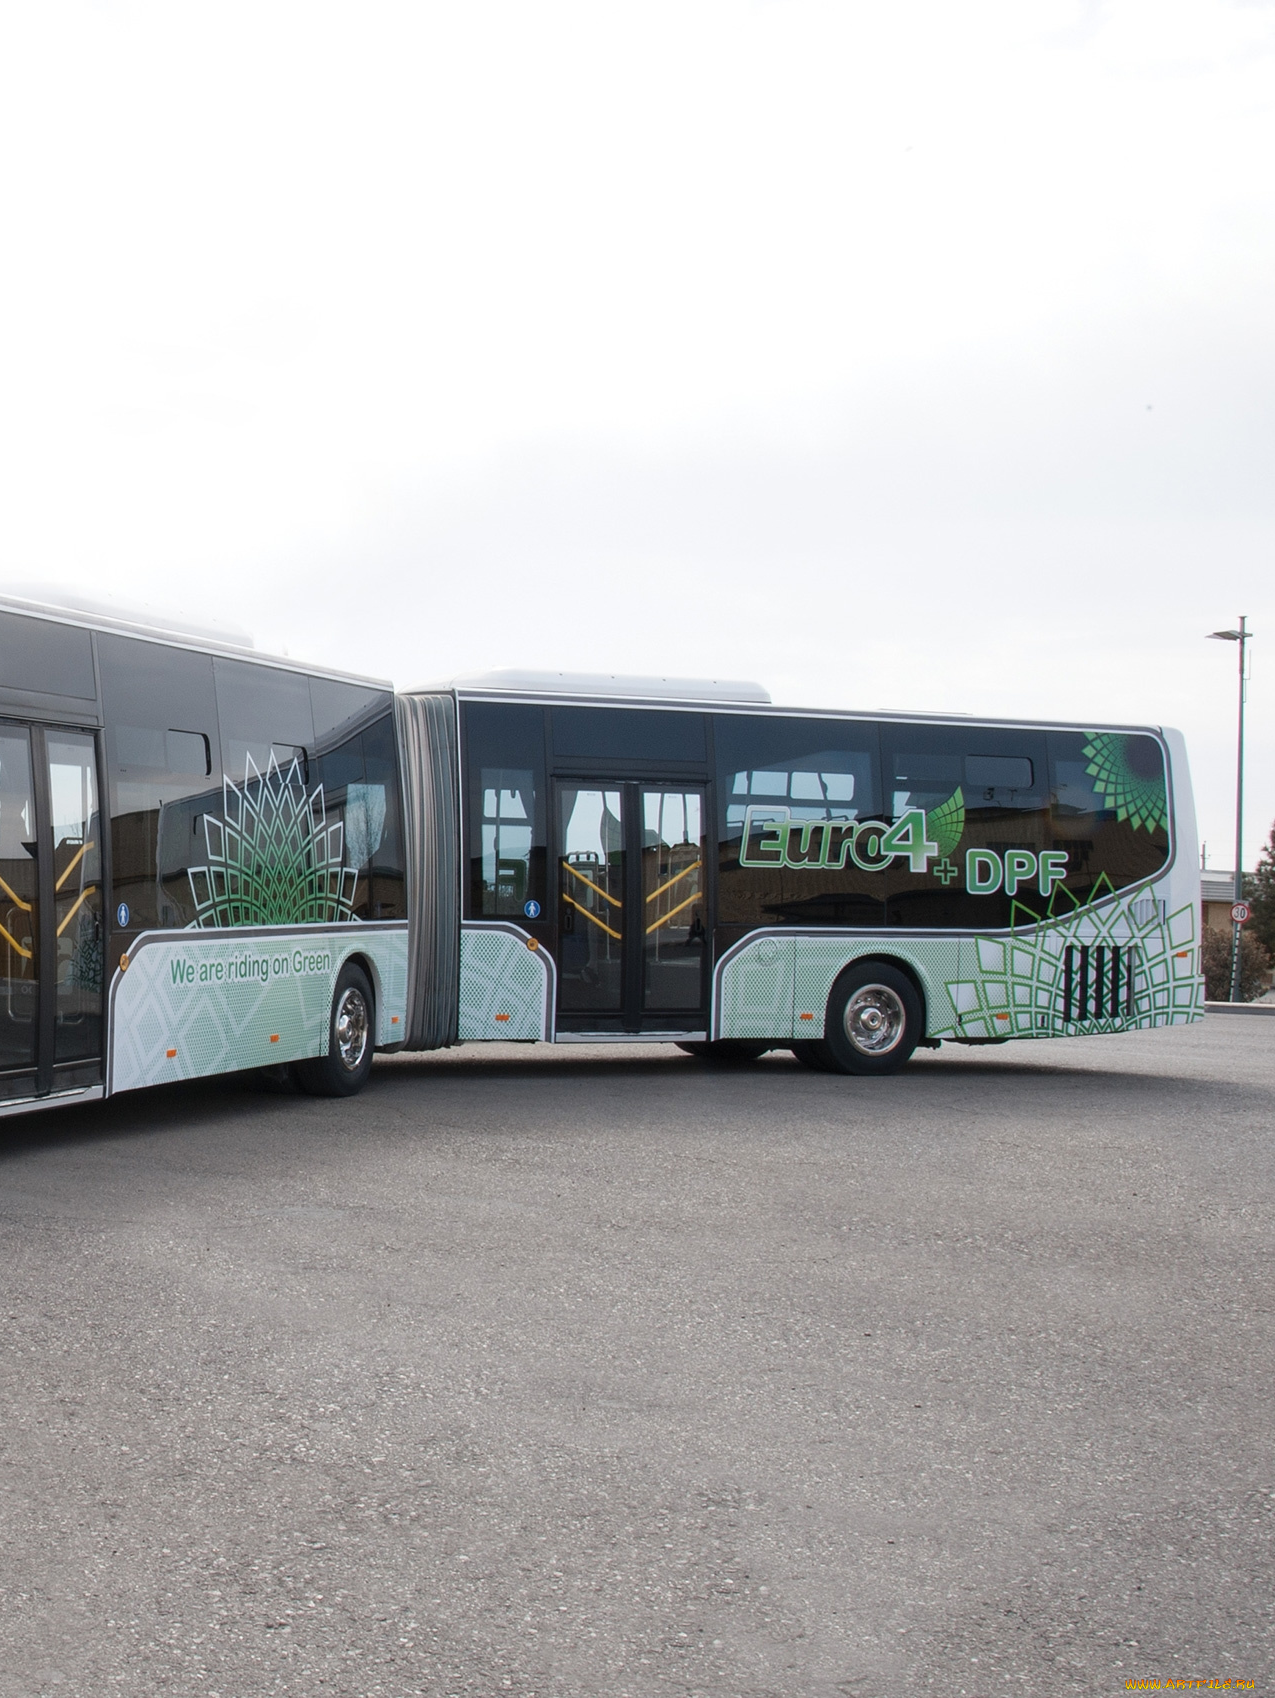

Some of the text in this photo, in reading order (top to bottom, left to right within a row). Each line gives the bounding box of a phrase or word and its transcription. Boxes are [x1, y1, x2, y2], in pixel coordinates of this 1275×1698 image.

[739, 804, 938, 873] Euro4
[966, 848, 1069, 896] DPF
[1234, 907, 1245, 919] 30
[171, 950, 331, 984] We are riding on Green
